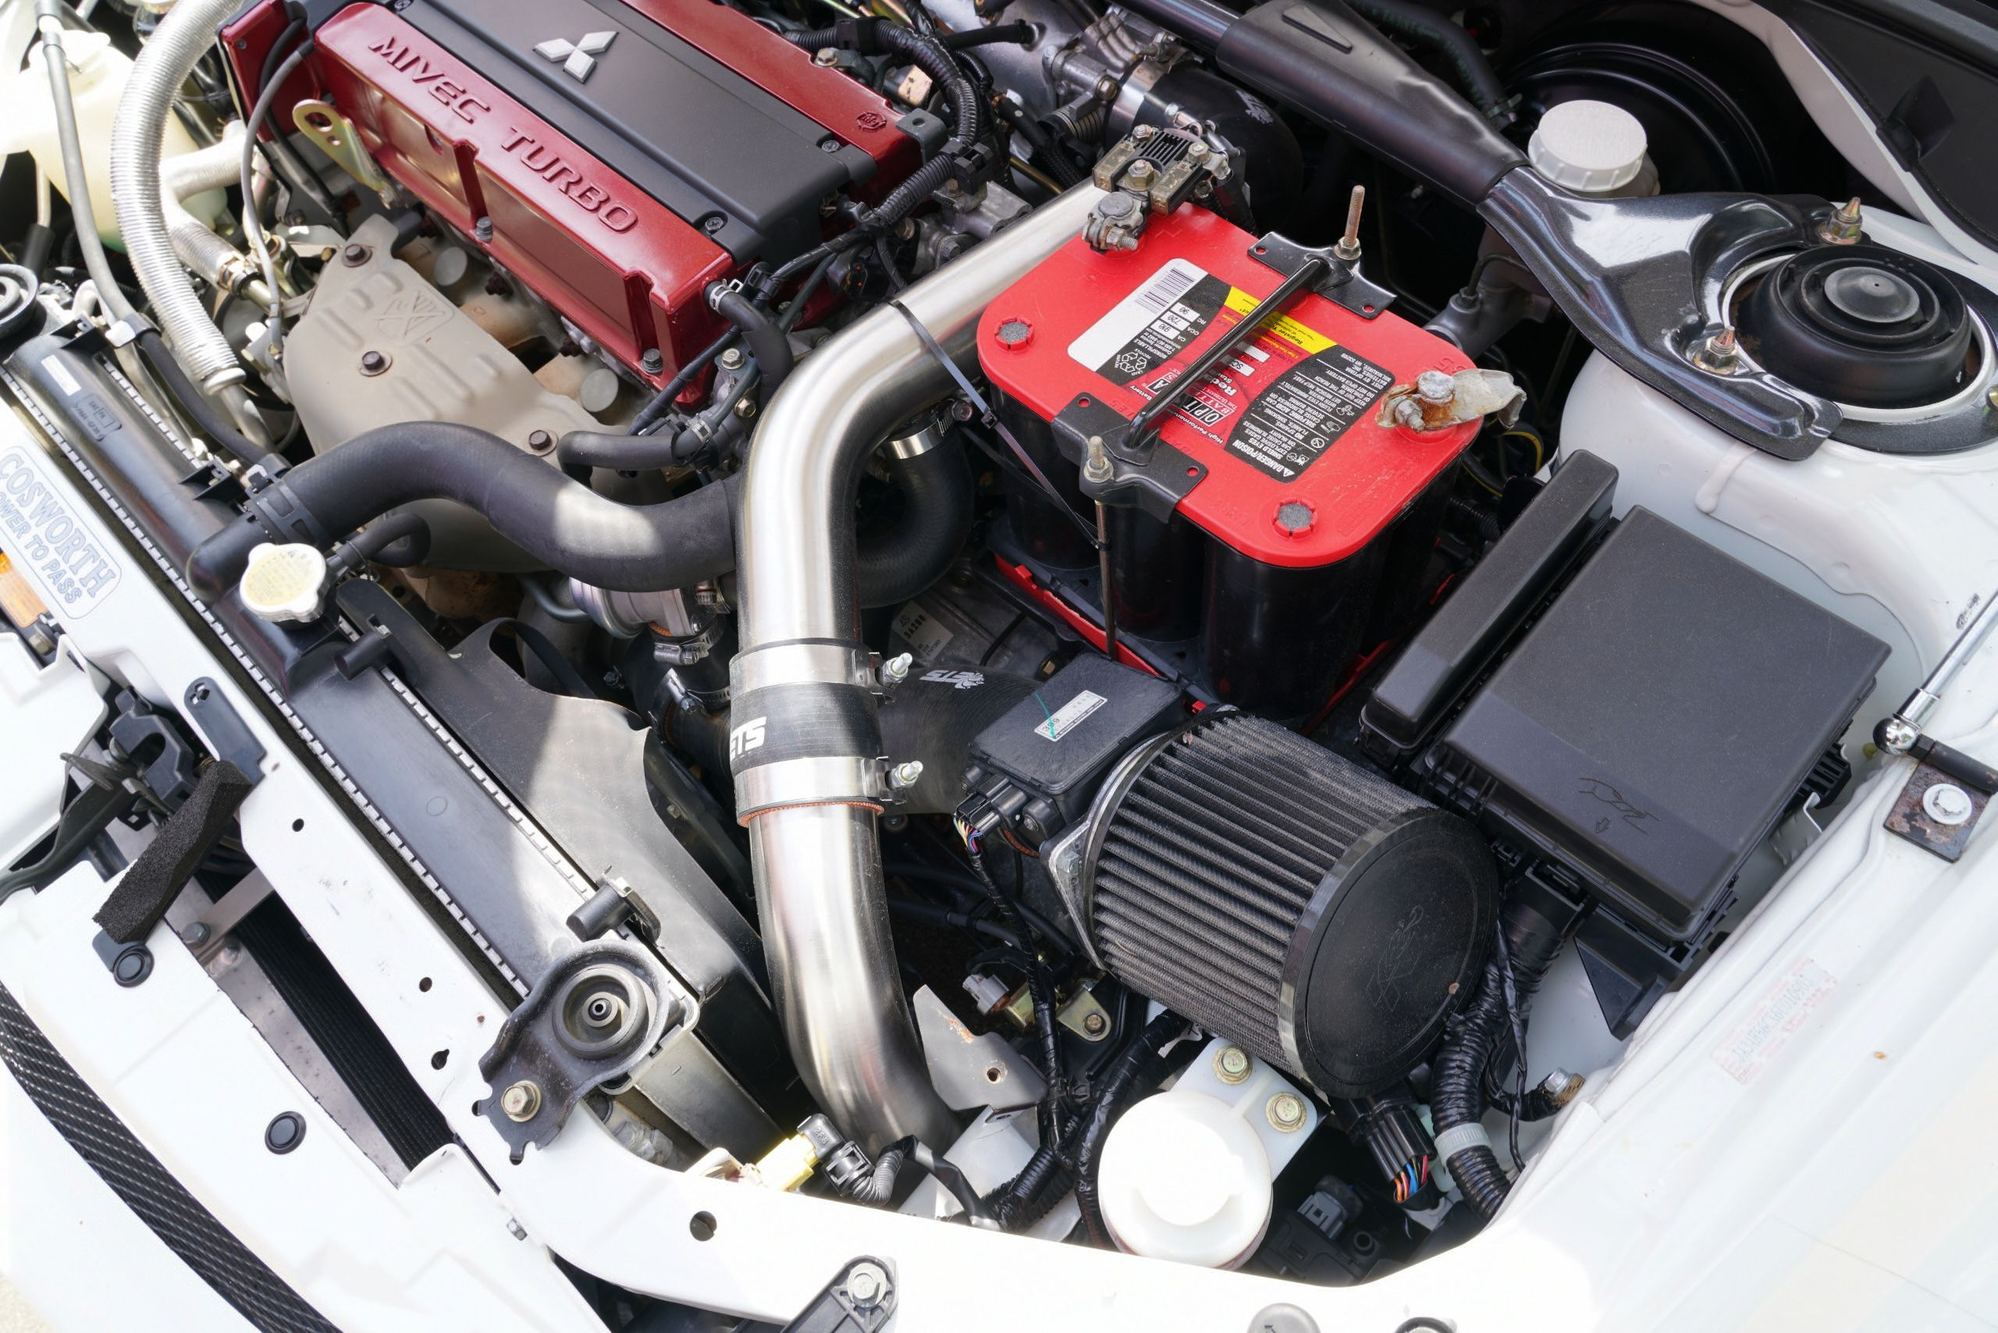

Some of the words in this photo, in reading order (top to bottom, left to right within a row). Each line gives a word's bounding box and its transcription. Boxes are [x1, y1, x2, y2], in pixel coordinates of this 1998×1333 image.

[367, 36, 492, 125] MIVEC
[500, 126, 640, 233] TURBO
[1185, 326, 1201, 336] CCA
[1128, 384, 1153, 400] Battery
[1206, 431, 1224, 443] High
[1247, 436, 1264, 448] EYES
[1231, 438, 1285, 472] DANGER/POISON
[0, 453, 117, 599] COSWORTH
[24, 534, 50, 561] TO
[41, 557, 83, 605] PASS
